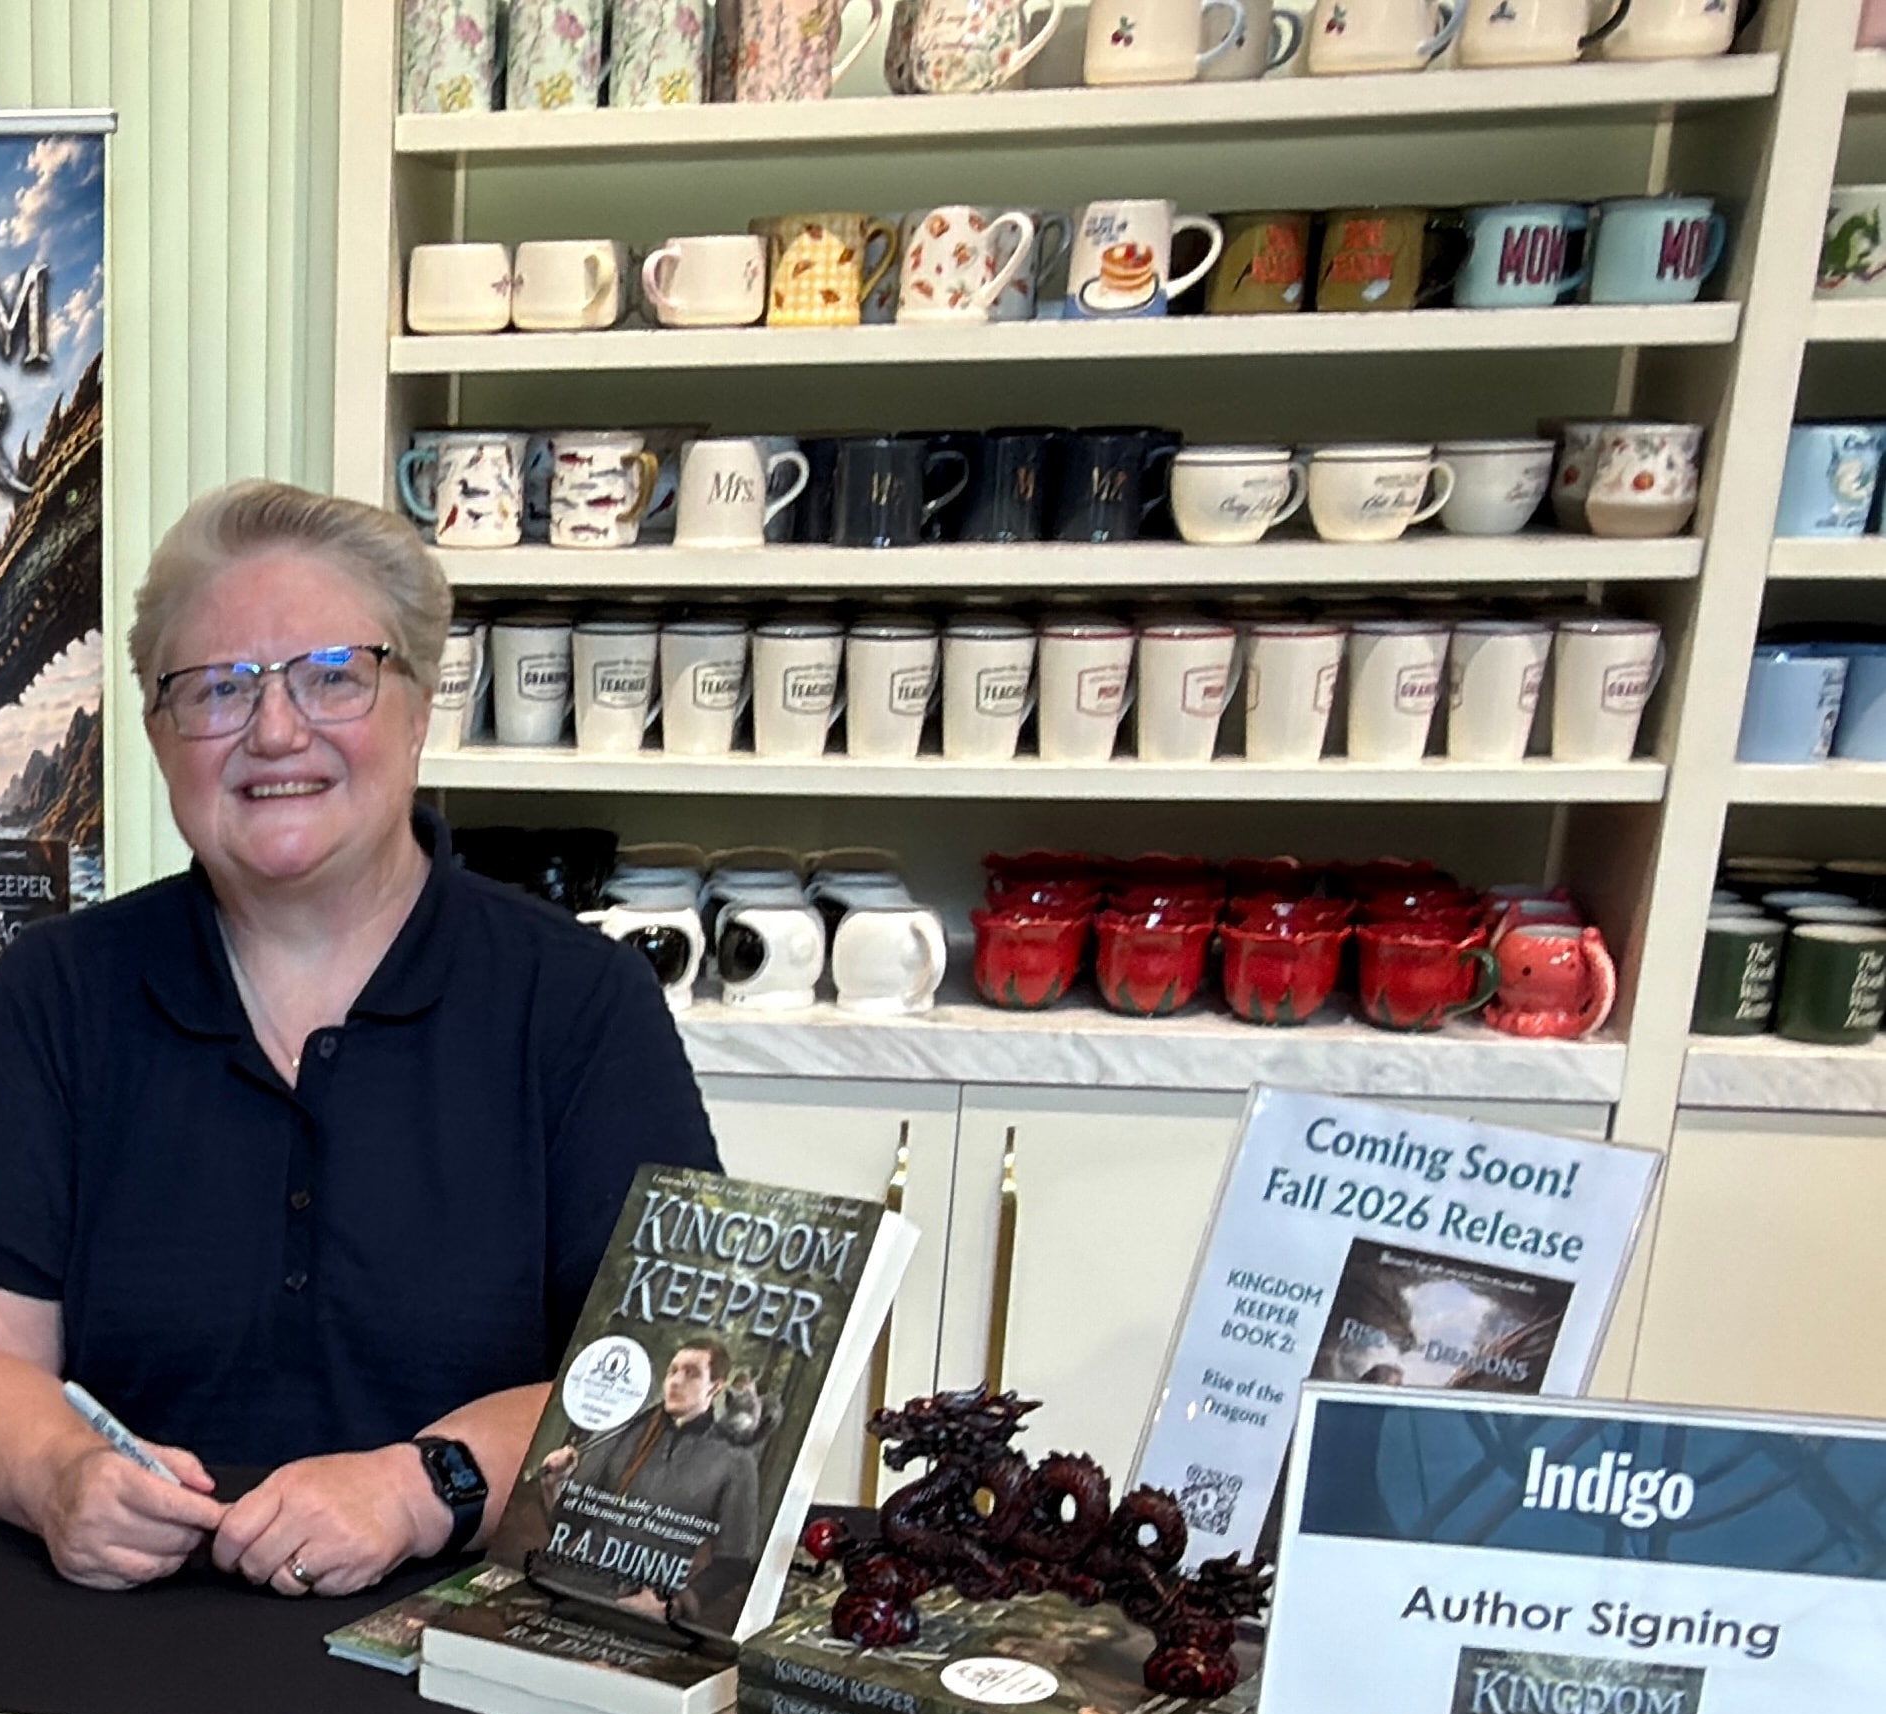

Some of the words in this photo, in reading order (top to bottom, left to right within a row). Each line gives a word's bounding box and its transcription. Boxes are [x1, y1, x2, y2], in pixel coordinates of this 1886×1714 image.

[1656, 218, 1709, 280] MO
[708, 471, 755, 504] Mrs.
[898, 684, 931, 700] TEAC
[1305, 1116, 1454, 1182] Coming
[1459, 1143, 1582, 1200] Soon!
[628, 1189, 858, 1284] KINGDOM
[1262, 1166, 1328, 1213] Fall
[1331, 1178, 1430, 1232] 2026
[1438, 1201, 1584, 1263] Release
[611, 1255, 823, 1359] KEEPER
[1226, 1268, 1324, 1308] KINGDOM
[1221, 1318, 1278, 1349] BOOK
[1233, 1297, 1300, 1328] KEEPER
[1202, 1367, 1235, 1393] Rise
[1236, 1378, 1256, 1397] of
[1256, 1383, 1285, 1404] the
[560, 1479, 581, 1496] The
[584, 1483, 651, 1513] Remarkable
[654, 1504, 720, 1535] Adventures
[564, 1499, 578, 1511] of
[627, 1514, 642, 1529] of
[547, 1522, 595, 1563] R.A.
[598, 1536, 693, 1592] DUNNE
[1400, 1583, 1573, 1635] Author
[1586, 1600, 1780, 1659] Signing
[774, 1659, 845, 1696] KINGDOM
